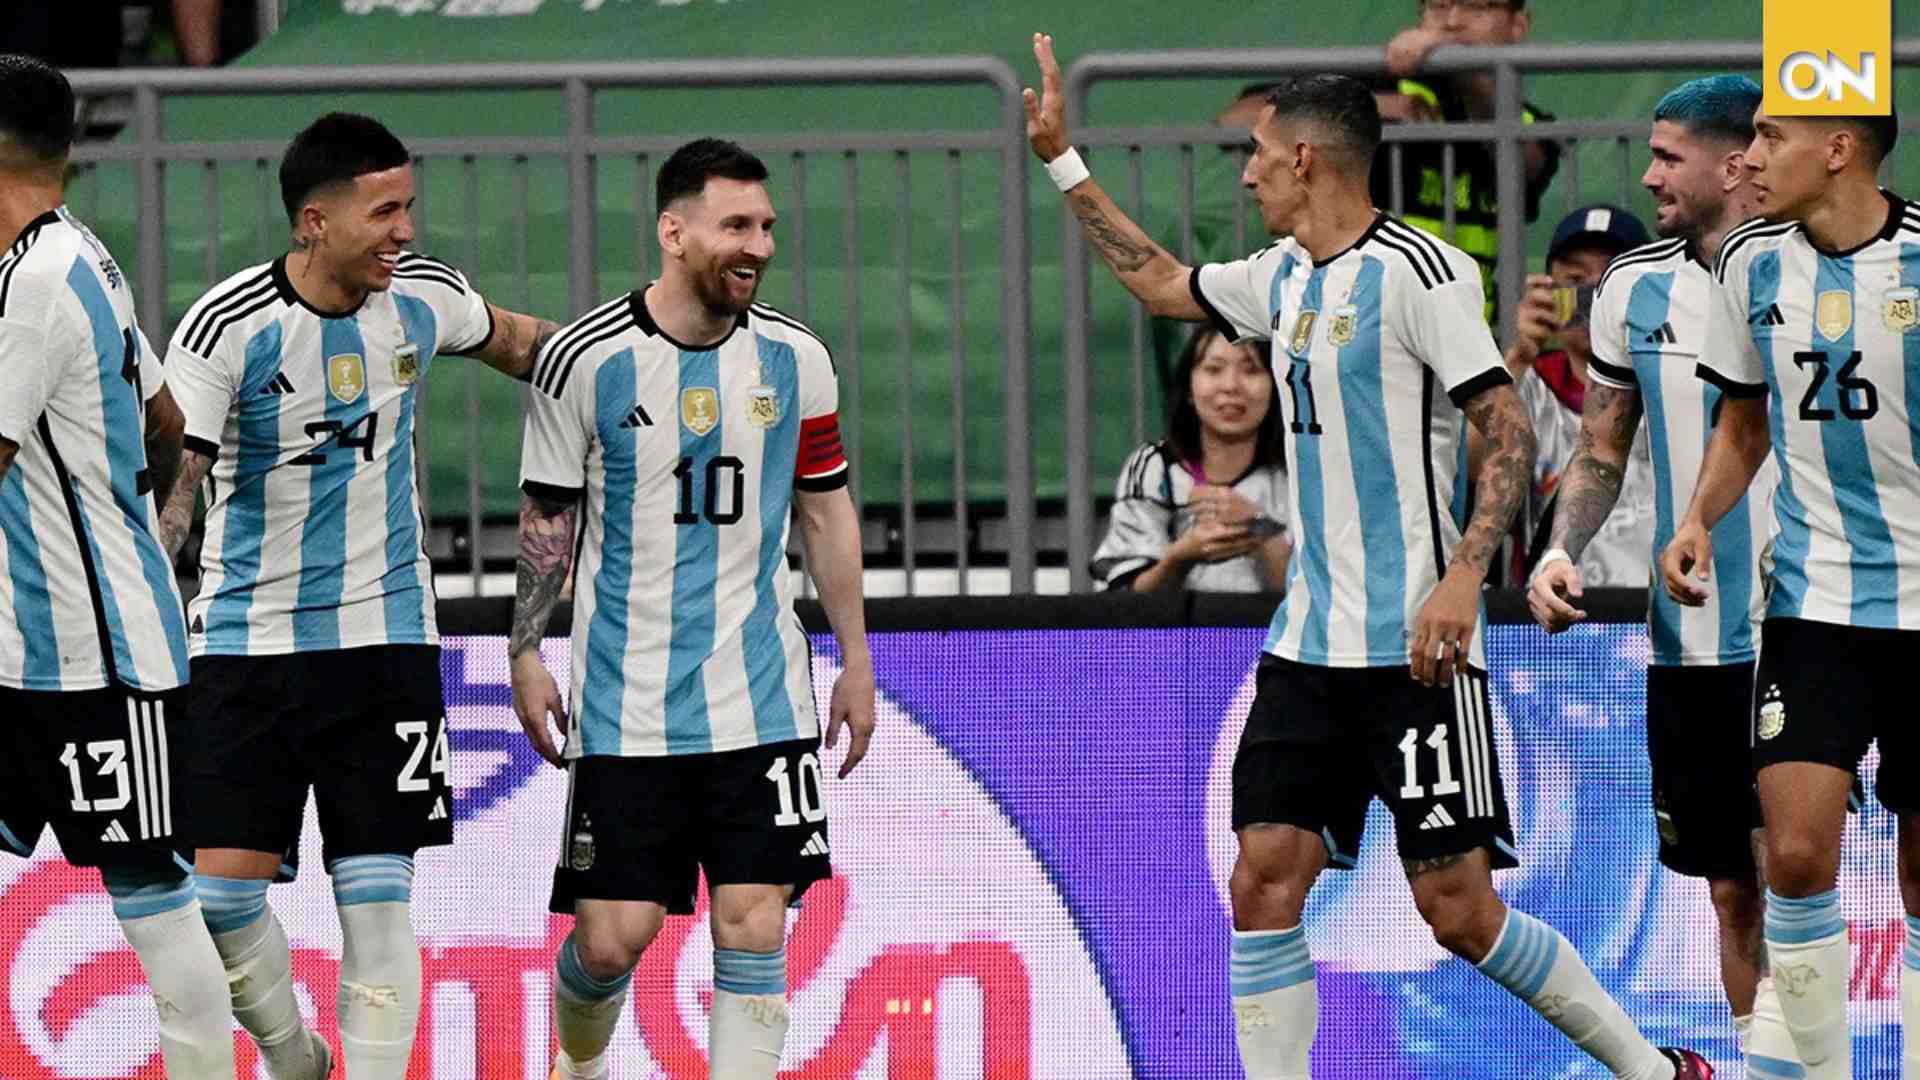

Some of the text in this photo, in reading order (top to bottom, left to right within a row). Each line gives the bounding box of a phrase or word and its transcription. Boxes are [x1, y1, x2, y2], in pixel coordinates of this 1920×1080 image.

[1285, 363, 1322, 434] 11
[1793, 350, 1879, 420] 26
[287, 412, 378, 465] 24
[672, 456, 744, 525] 10
[59, 739, 131, 811] 13
[395, 717, 449, 792] 24
[765, 752, 826, 826] 10
[1397, 723, 1460, 799] 11
